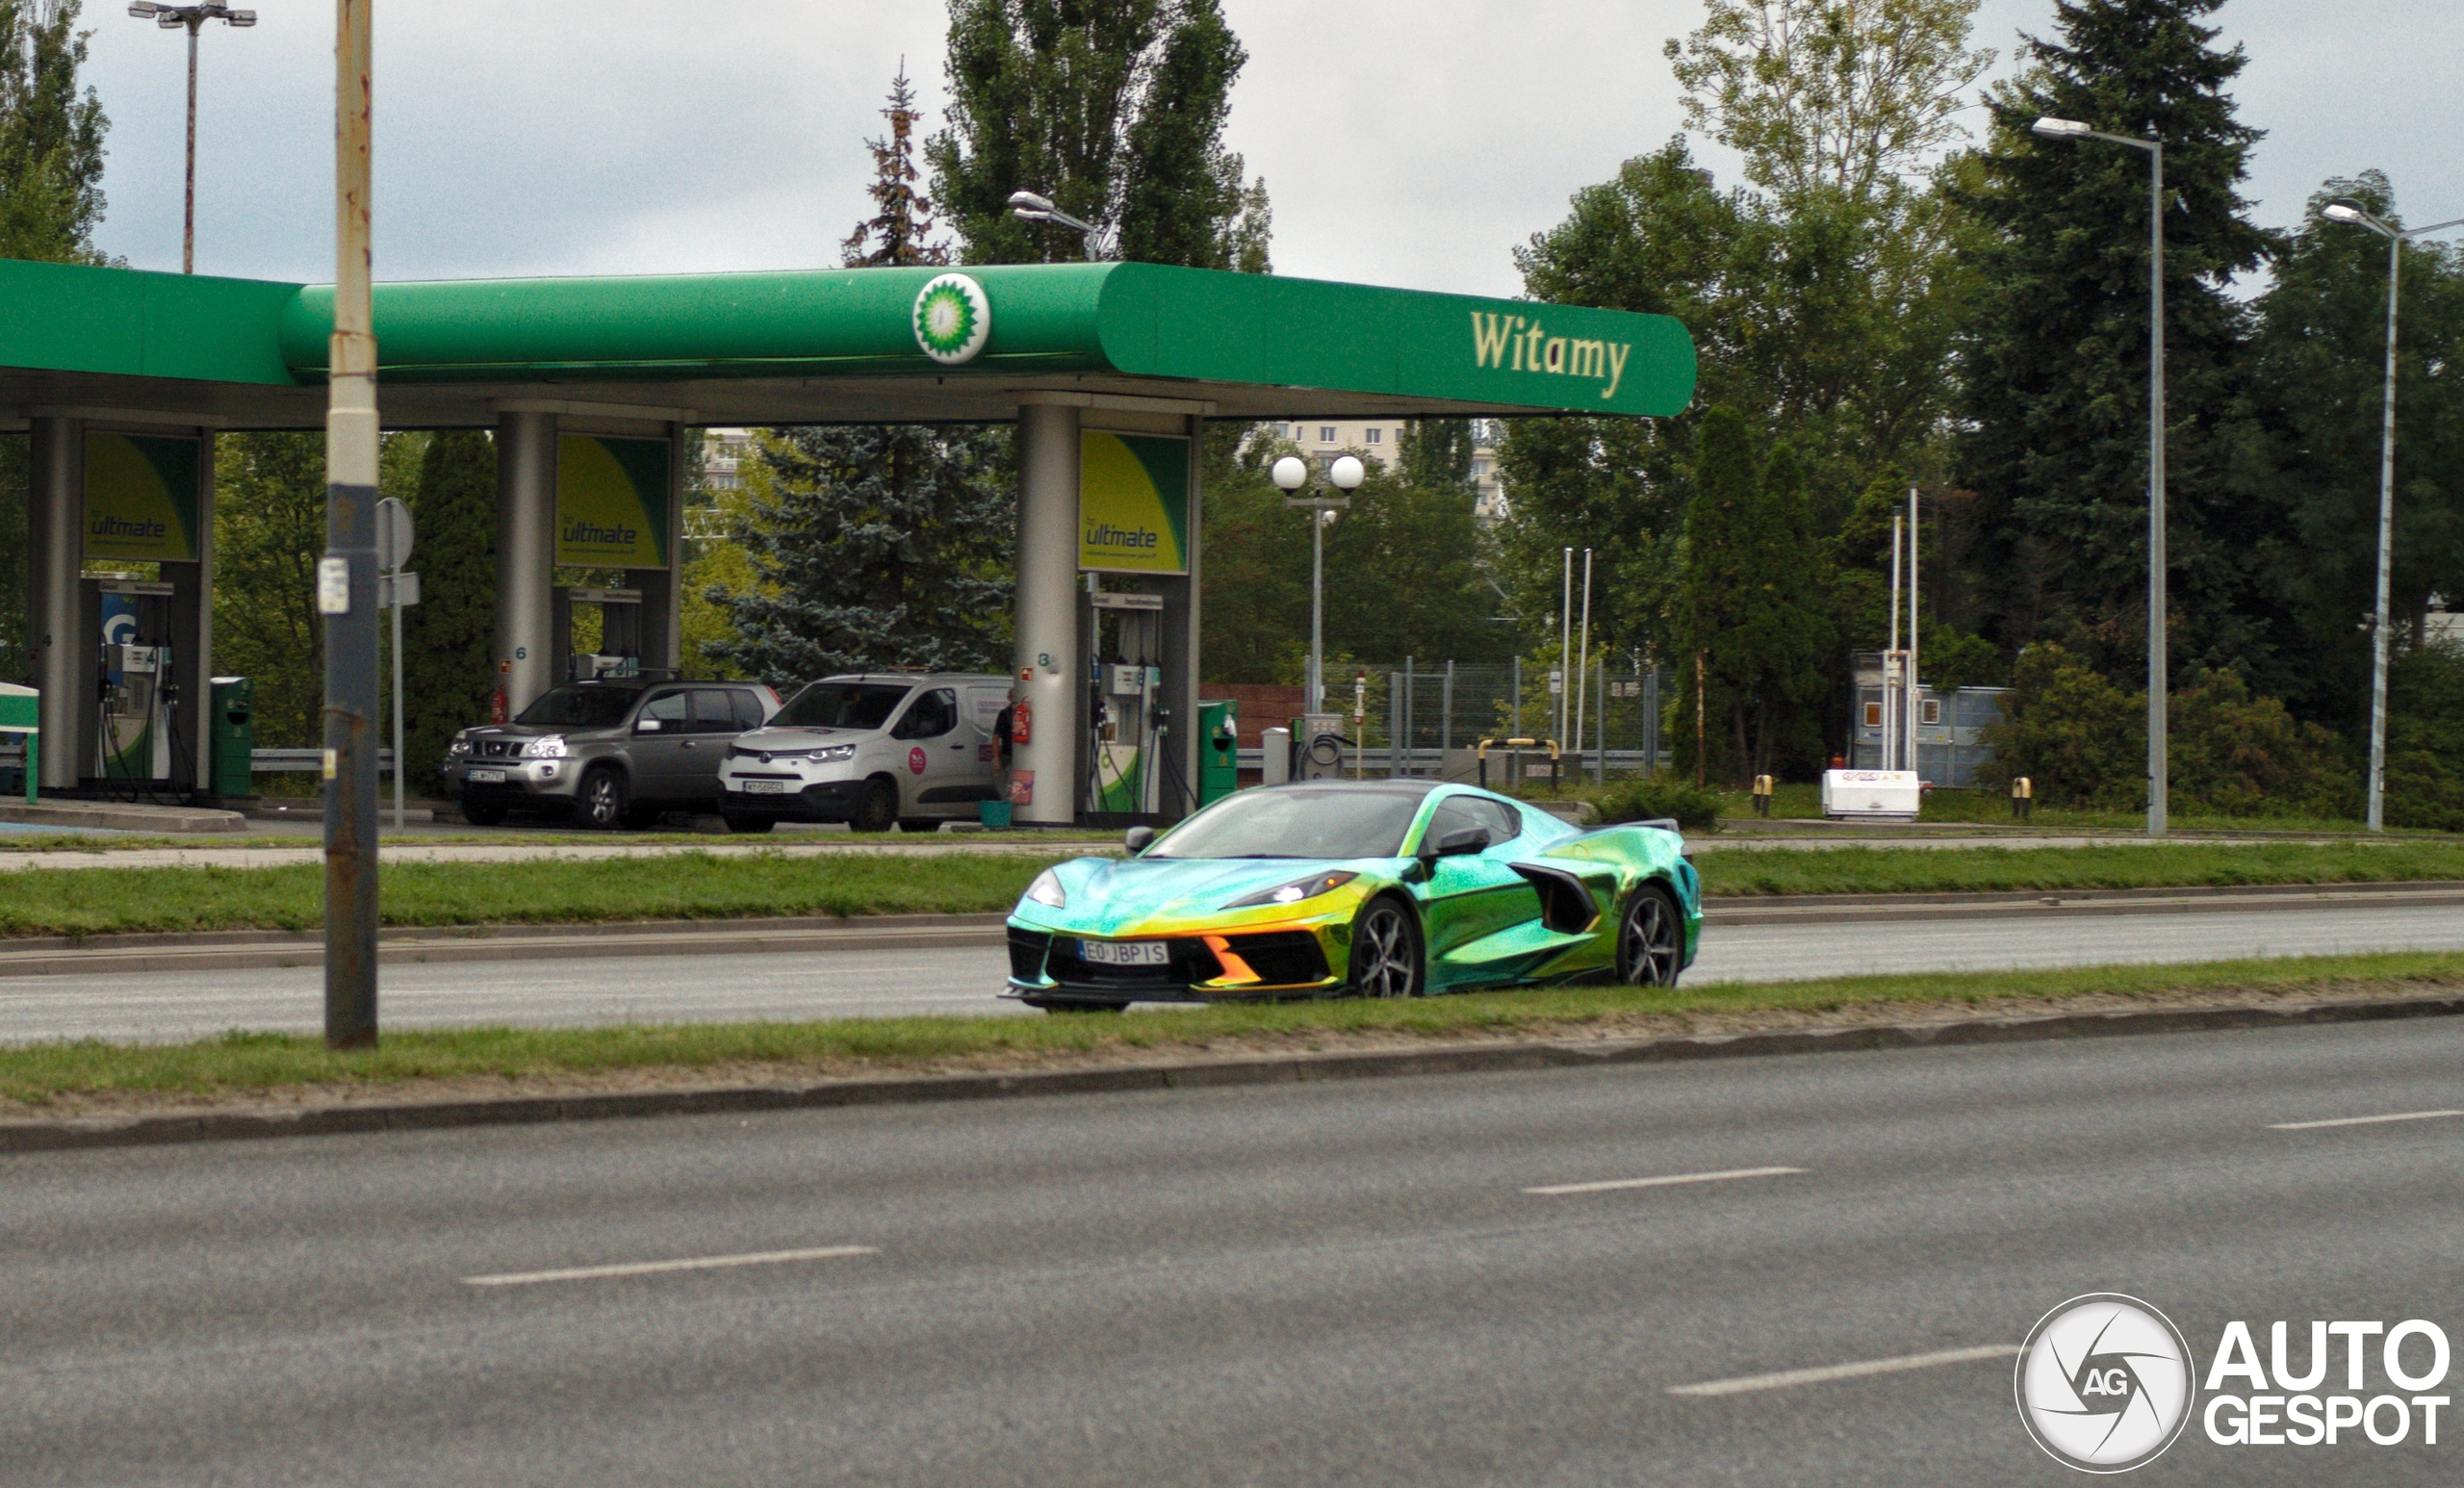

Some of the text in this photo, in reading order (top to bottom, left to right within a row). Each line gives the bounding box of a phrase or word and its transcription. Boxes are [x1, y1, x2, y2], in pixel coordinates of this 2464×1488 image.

[1471, 312, 1631, 399] Witamy
[91, 516, 167, 538] ultimate
[563, 522, 637, 545] ultimate
[1086, 524, 1157, 548] ultimate
[515, 647, 526, 659] 6
[1038, 653, 1050, 666] 3
